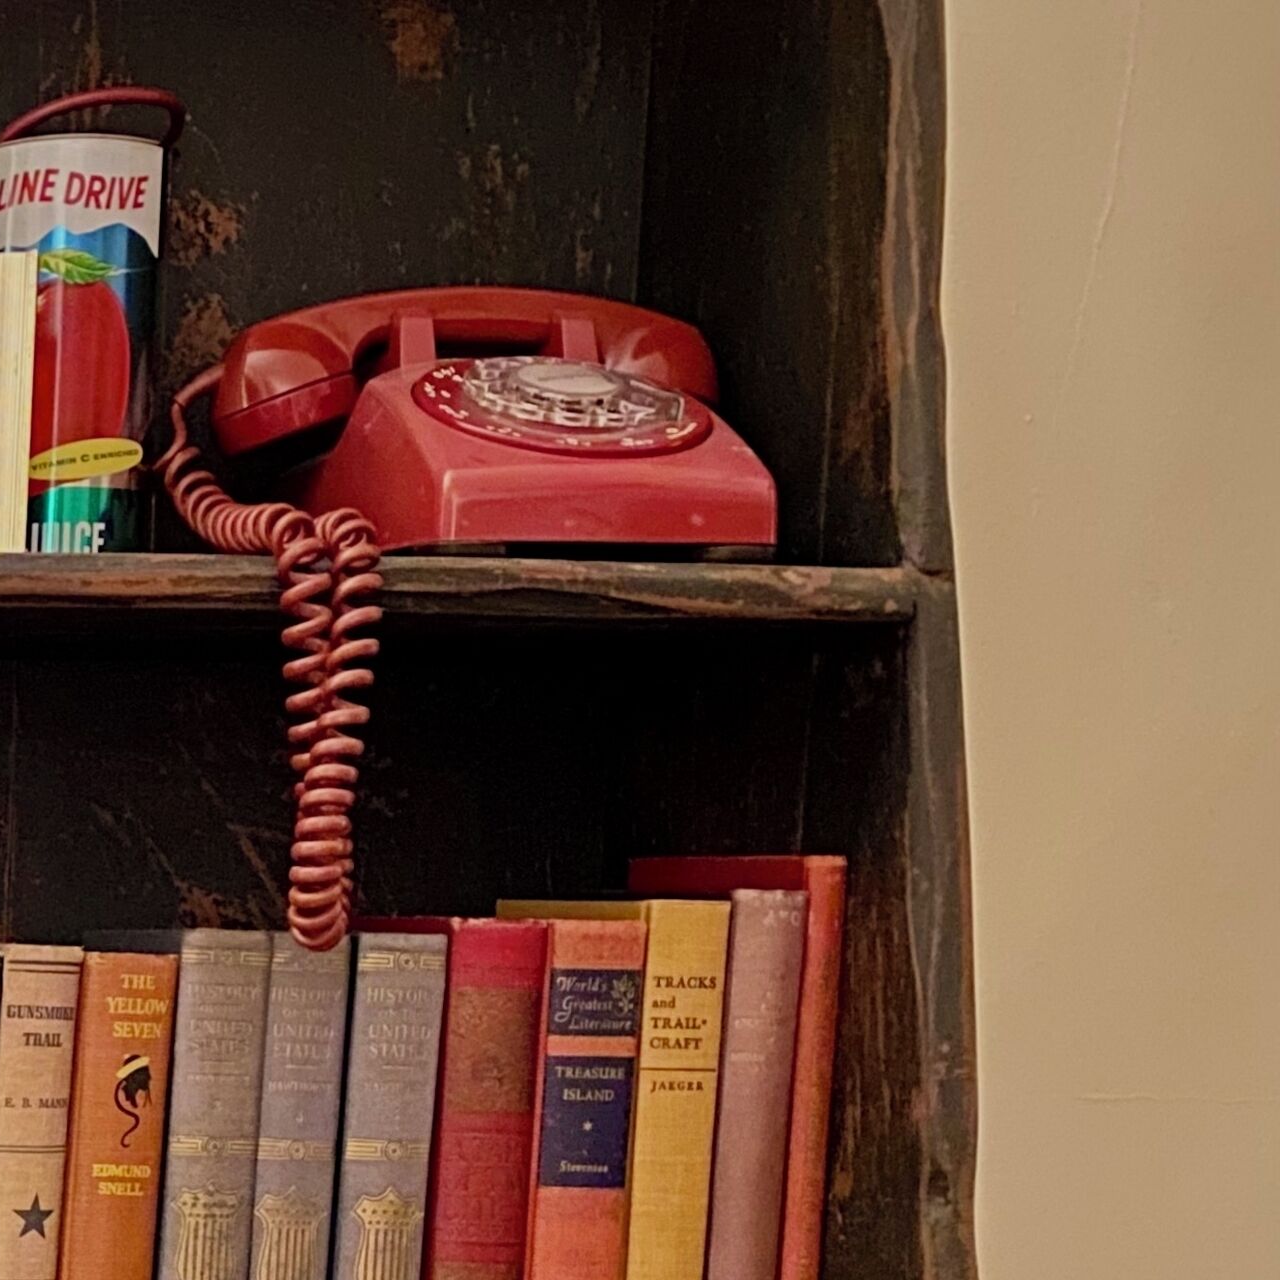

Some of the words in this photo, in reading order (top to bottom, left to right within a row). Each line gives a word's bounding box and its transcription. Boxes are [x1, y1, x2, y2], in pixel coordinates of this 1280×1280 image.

[64, 172, 149, 210] DRIVE
[31, 457, 77, 471] VITAMIN
[80, 454, 91, 463] C
[93, 449, 139, 461] ENRICHED
[121, 973, 156, 990] THE
[555, 975, 608, 994] World's
[653, 976, 717, 989] TRACKS
[106, 997, 169, 1016] YELLOW
[652, 996, 676, 1010] and
[6, 1004, 75, 1021] GUNSMOKE
[113, 1022, 162, 1039] SEVEN
[569, 1015, 633, 1031] Literature
[23, 1032, 63, 1047] TRAIL
[650, 1037, 703, 1051] CRAFT
[555, 1065, 626, 1080] TREASURE
[562, 1088, 615, 1102] ISLAND
[650, 1081, 705, 1094] JAEGER
[92, 1163, 152, 1179] EDMUND
[98, 1182, 144, 1197] SNELL
